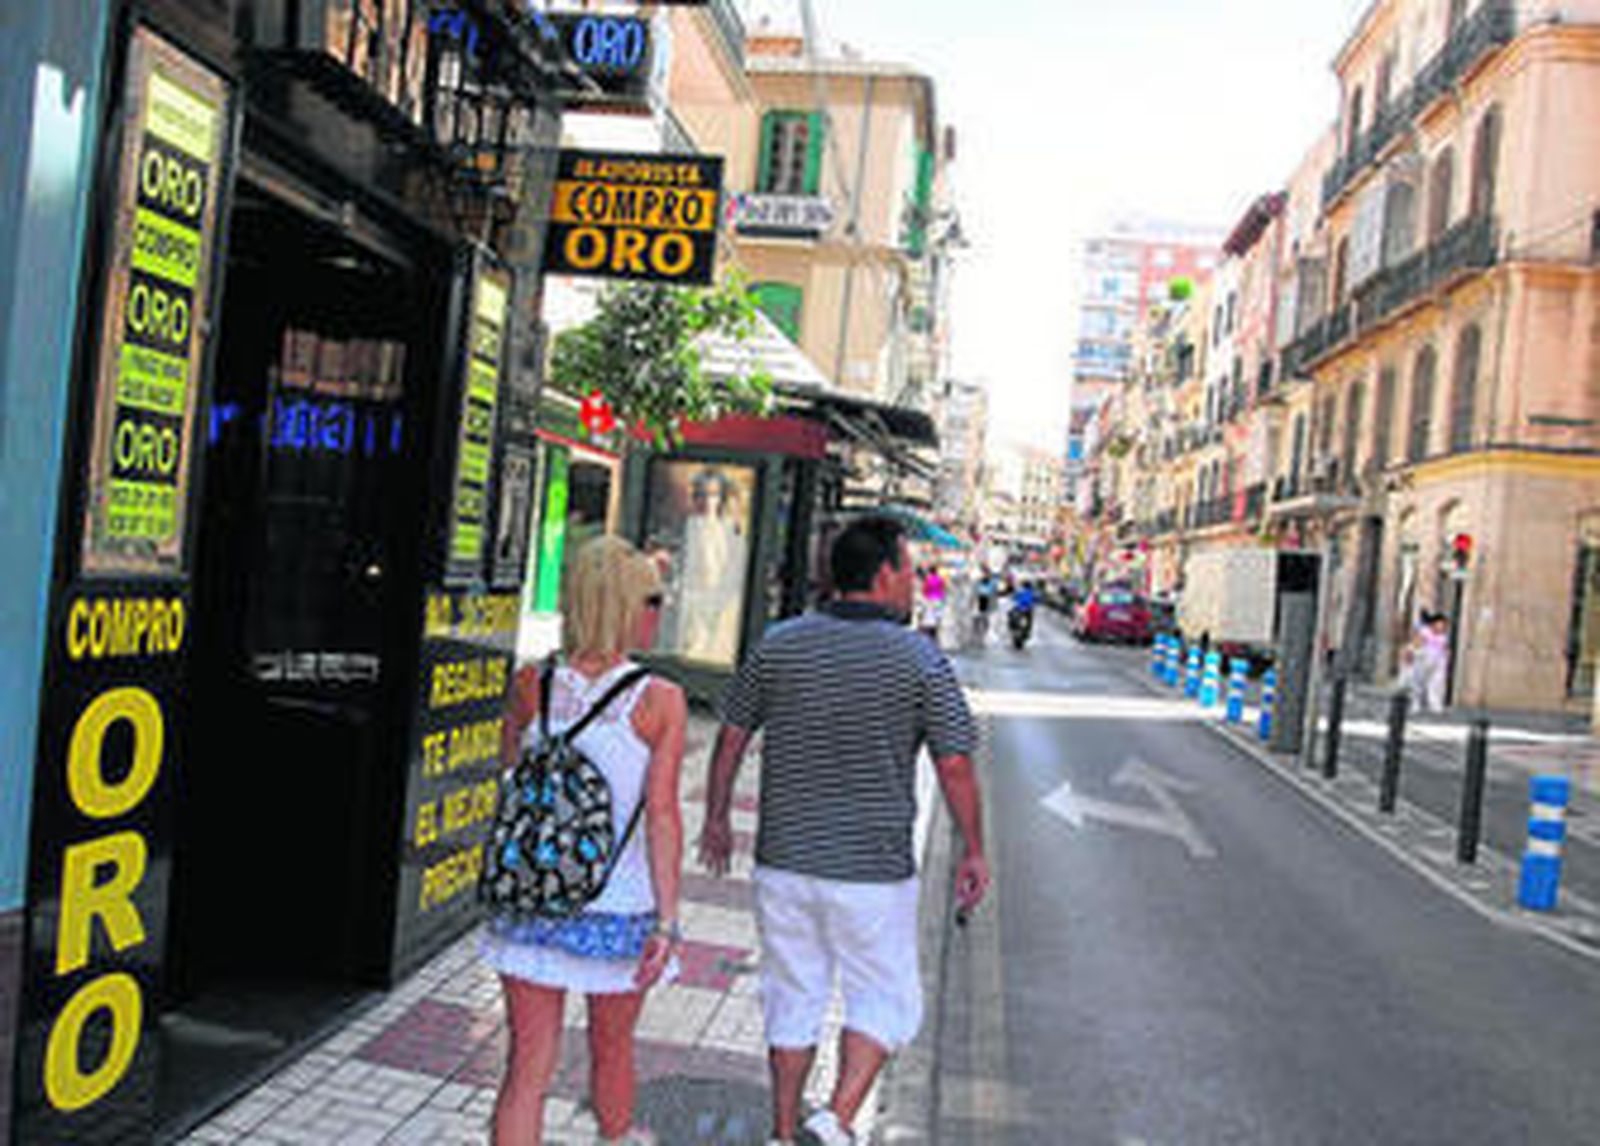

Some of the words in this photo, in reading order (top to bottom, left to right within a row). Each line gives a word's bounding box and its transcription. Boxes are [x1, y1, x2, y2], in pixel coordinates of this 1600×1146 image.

[574, 18, 643, 66] ORO
[141, 150, 202, 217] ORO
[569, 185, 705, 226] COMPRO
[563, 226, 695, 276] ORO
[127, 283, 190, 343] ORO
[115, 419, 178, 473] ORO
[67, 598, 185, 660] COMPRO
[422, 731, 446, 778] TE
[415, 801, 438, 848] EL
[43, 686, 165, 1112] ORO
